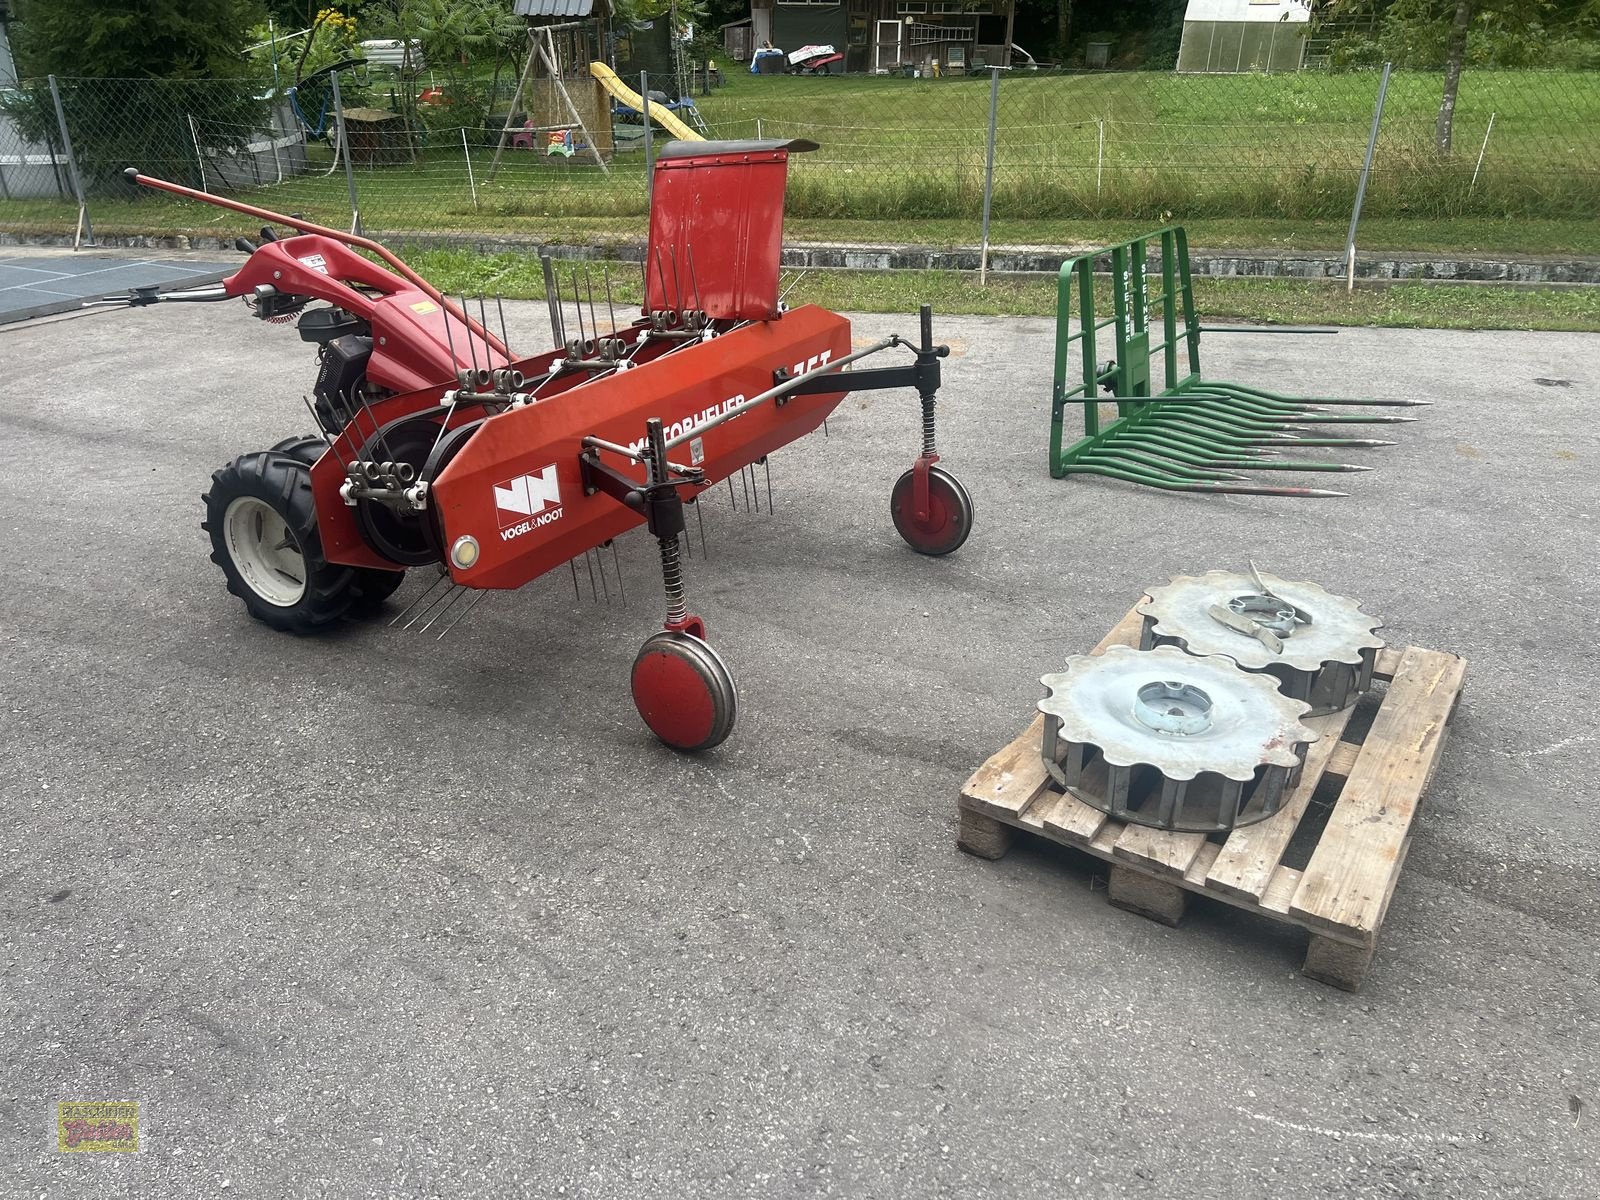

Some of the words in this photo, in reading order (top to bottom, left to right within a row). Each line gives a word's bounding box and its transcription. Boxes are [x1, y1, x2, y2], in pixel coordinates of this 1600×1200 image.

[1123, 270, 1131, 343] STEINER
[1141, 263, 1149, 334] STEINER
[628, 394, 747, 466] MTORHEUER
[500, 508, 563, 541] VOGEL&NOOT
